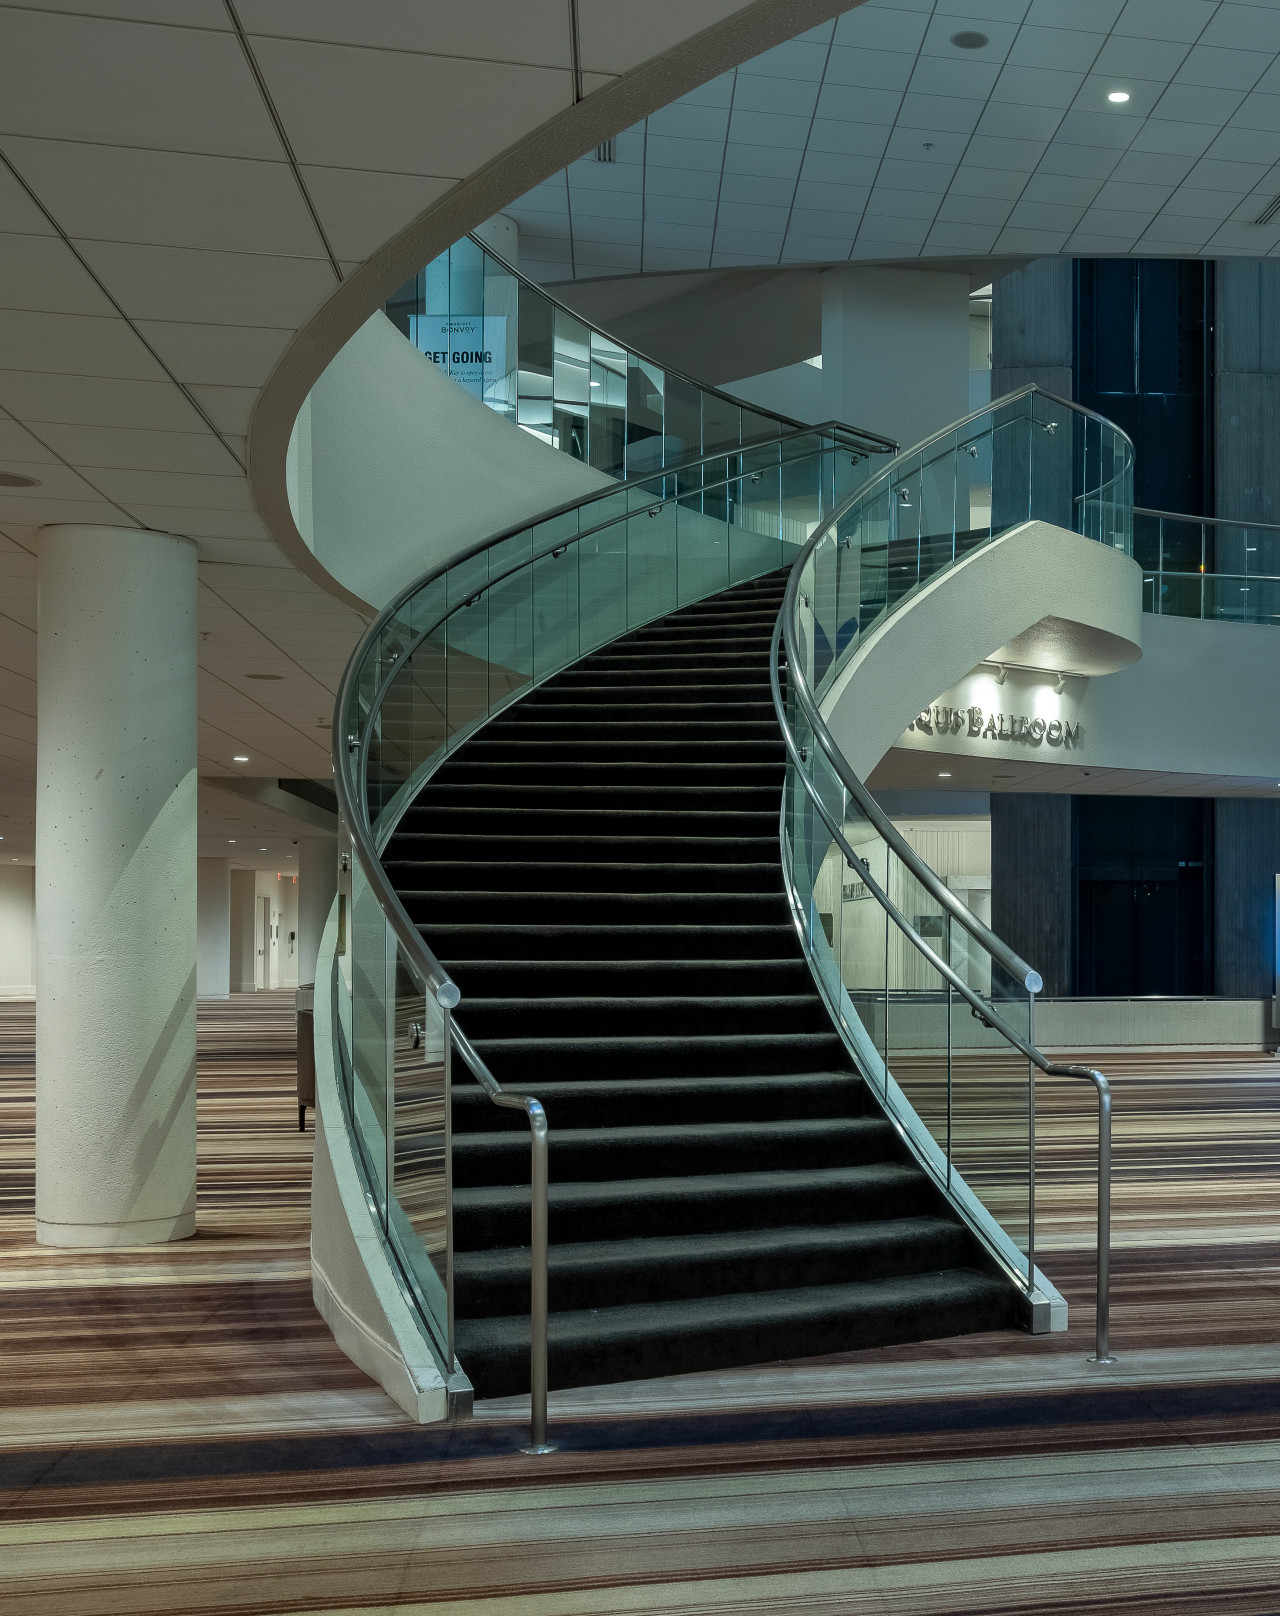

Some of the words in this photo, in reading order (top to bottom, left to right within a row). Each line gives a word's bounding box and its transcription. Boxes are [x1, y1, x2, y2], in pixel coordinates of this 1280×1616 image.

[441, 326, 475, 334] BONVOY
[425, 351, 449, 364] GET
[452, 351, 492, 364] GOING
[970, 706, 1080, 743] BALLROOM
